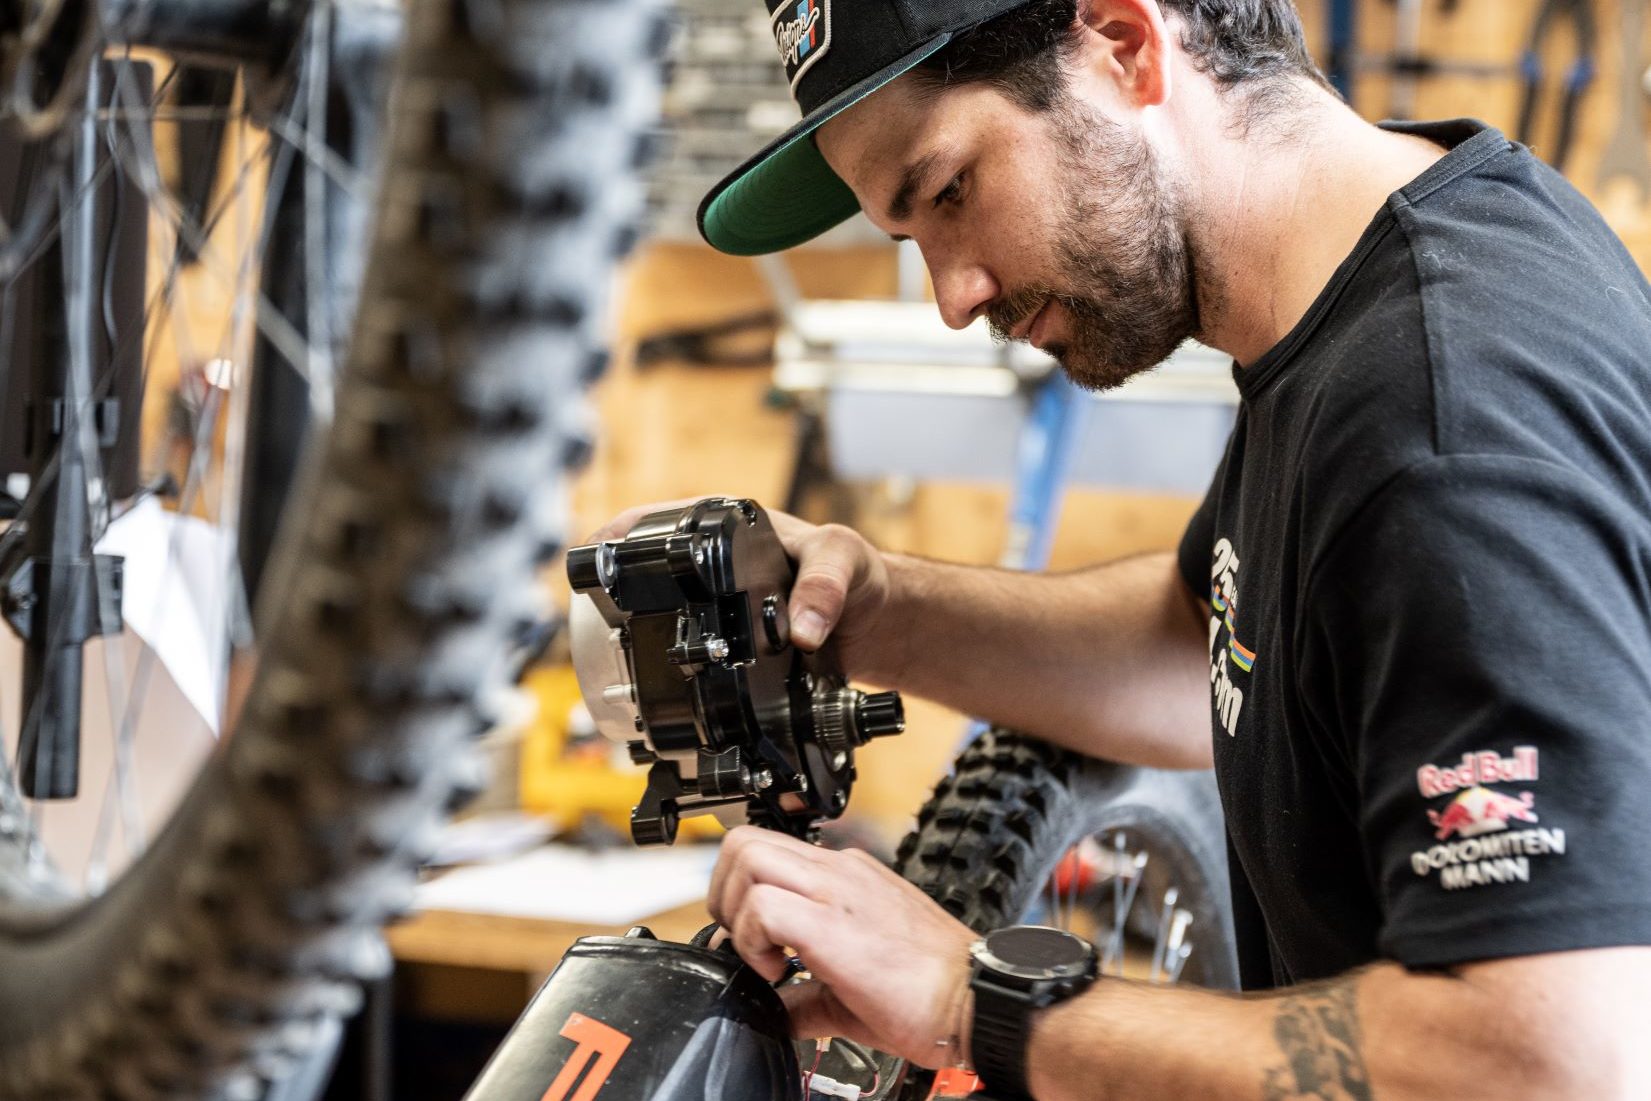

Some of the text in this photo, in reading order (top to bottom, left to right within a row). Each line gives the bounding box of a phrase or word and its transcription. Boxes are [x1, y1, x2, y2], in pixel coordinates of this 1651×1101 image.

[1417, 745, 1539, 798] Red Bull
[1411, 827, 1566, 876] DOLOMITEN
[1440, 856, 1530, 890] MANN
